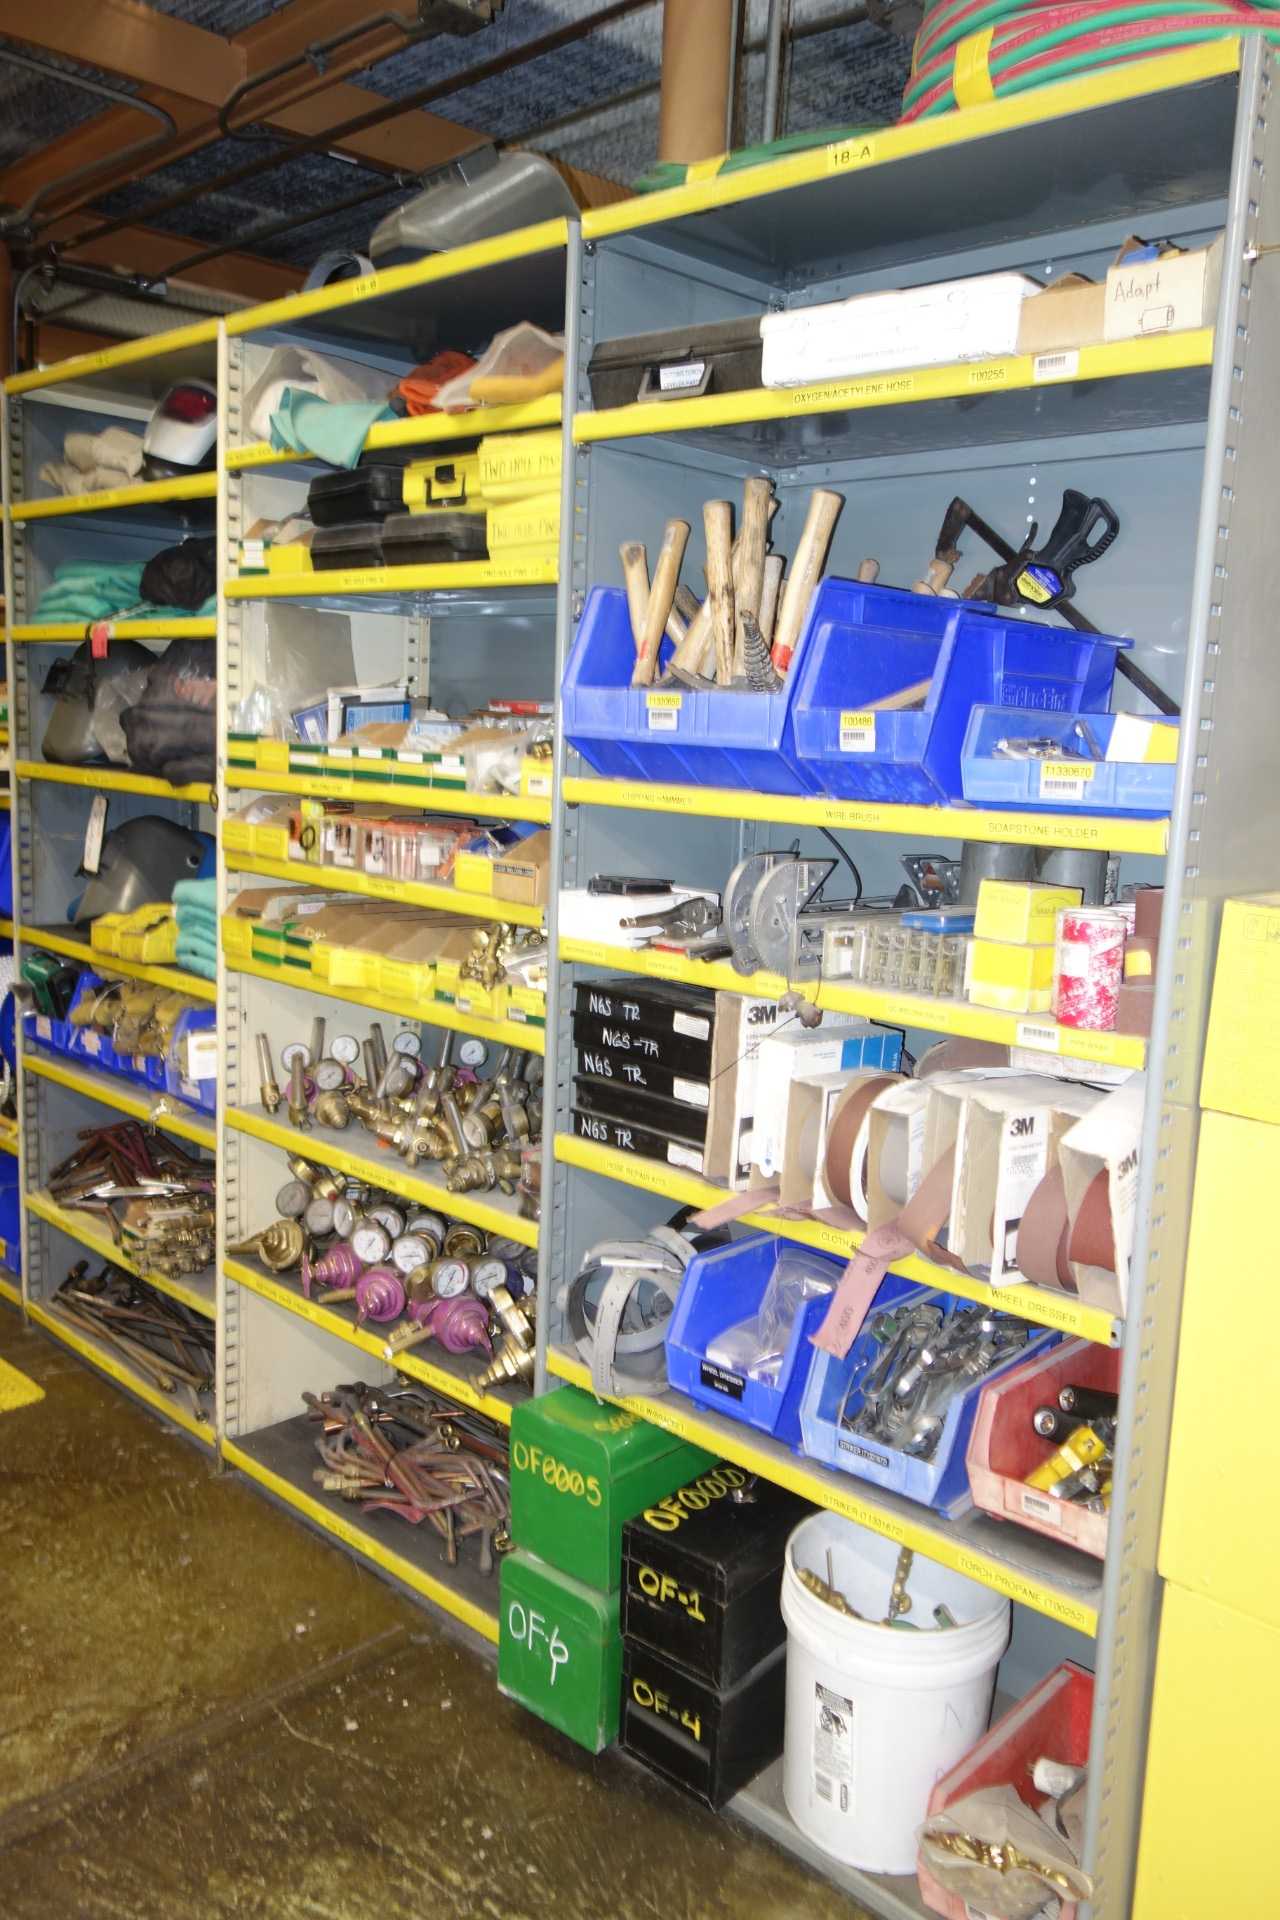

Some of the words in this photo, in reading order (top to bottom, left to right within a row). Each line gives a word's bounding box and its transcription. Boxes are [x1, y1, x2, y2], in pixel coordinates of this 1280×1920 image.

[834, 145, 871, 167] 18-A
[1114, 272, 1161, 303] Adapt
[794, 382, 884, 403] OXYGEN/ACETYLENE
[886, 379, 912, 393] HOSE
[825, 807, 847, 819] WIRE
[849, 809, 880, 822] BRUSH
[987, 822, 1050, 836] SOAPSTONE
[1053, 827, 1099, 839] HOLDER
[589, 992, 612, 1017] NGS
[622, 1002, 641, 1021] TR
[747, 1005, 777, 1025] 3M
[584, 1052, 613, 1078] NGS
[622, 1064, 648, 1085] TR
[581, 1117, 608, 1141] NGS
[615, 1128, 636, 1150] TR
[1010, 1116, 1035, 1136] 3M
[1118, 1149, 1138, 1180] 3M
[821, 1231, 849, 1247] CLOTH
[992, 1289, 1025, 1307] WHEEL
[1027, 1301, 1077, 1326] DRESSER
[514, 1441, 602, 1507] OF0005
[823, 1493, 859, 1518] STRIKER
[961, 1557, 992, 1579] TORCH
[994, 1575, 1041, 1602] PROPANE
[638, 1566, 706, 1624] OF-1
[633, 1678, 701, 1742] OF-4
